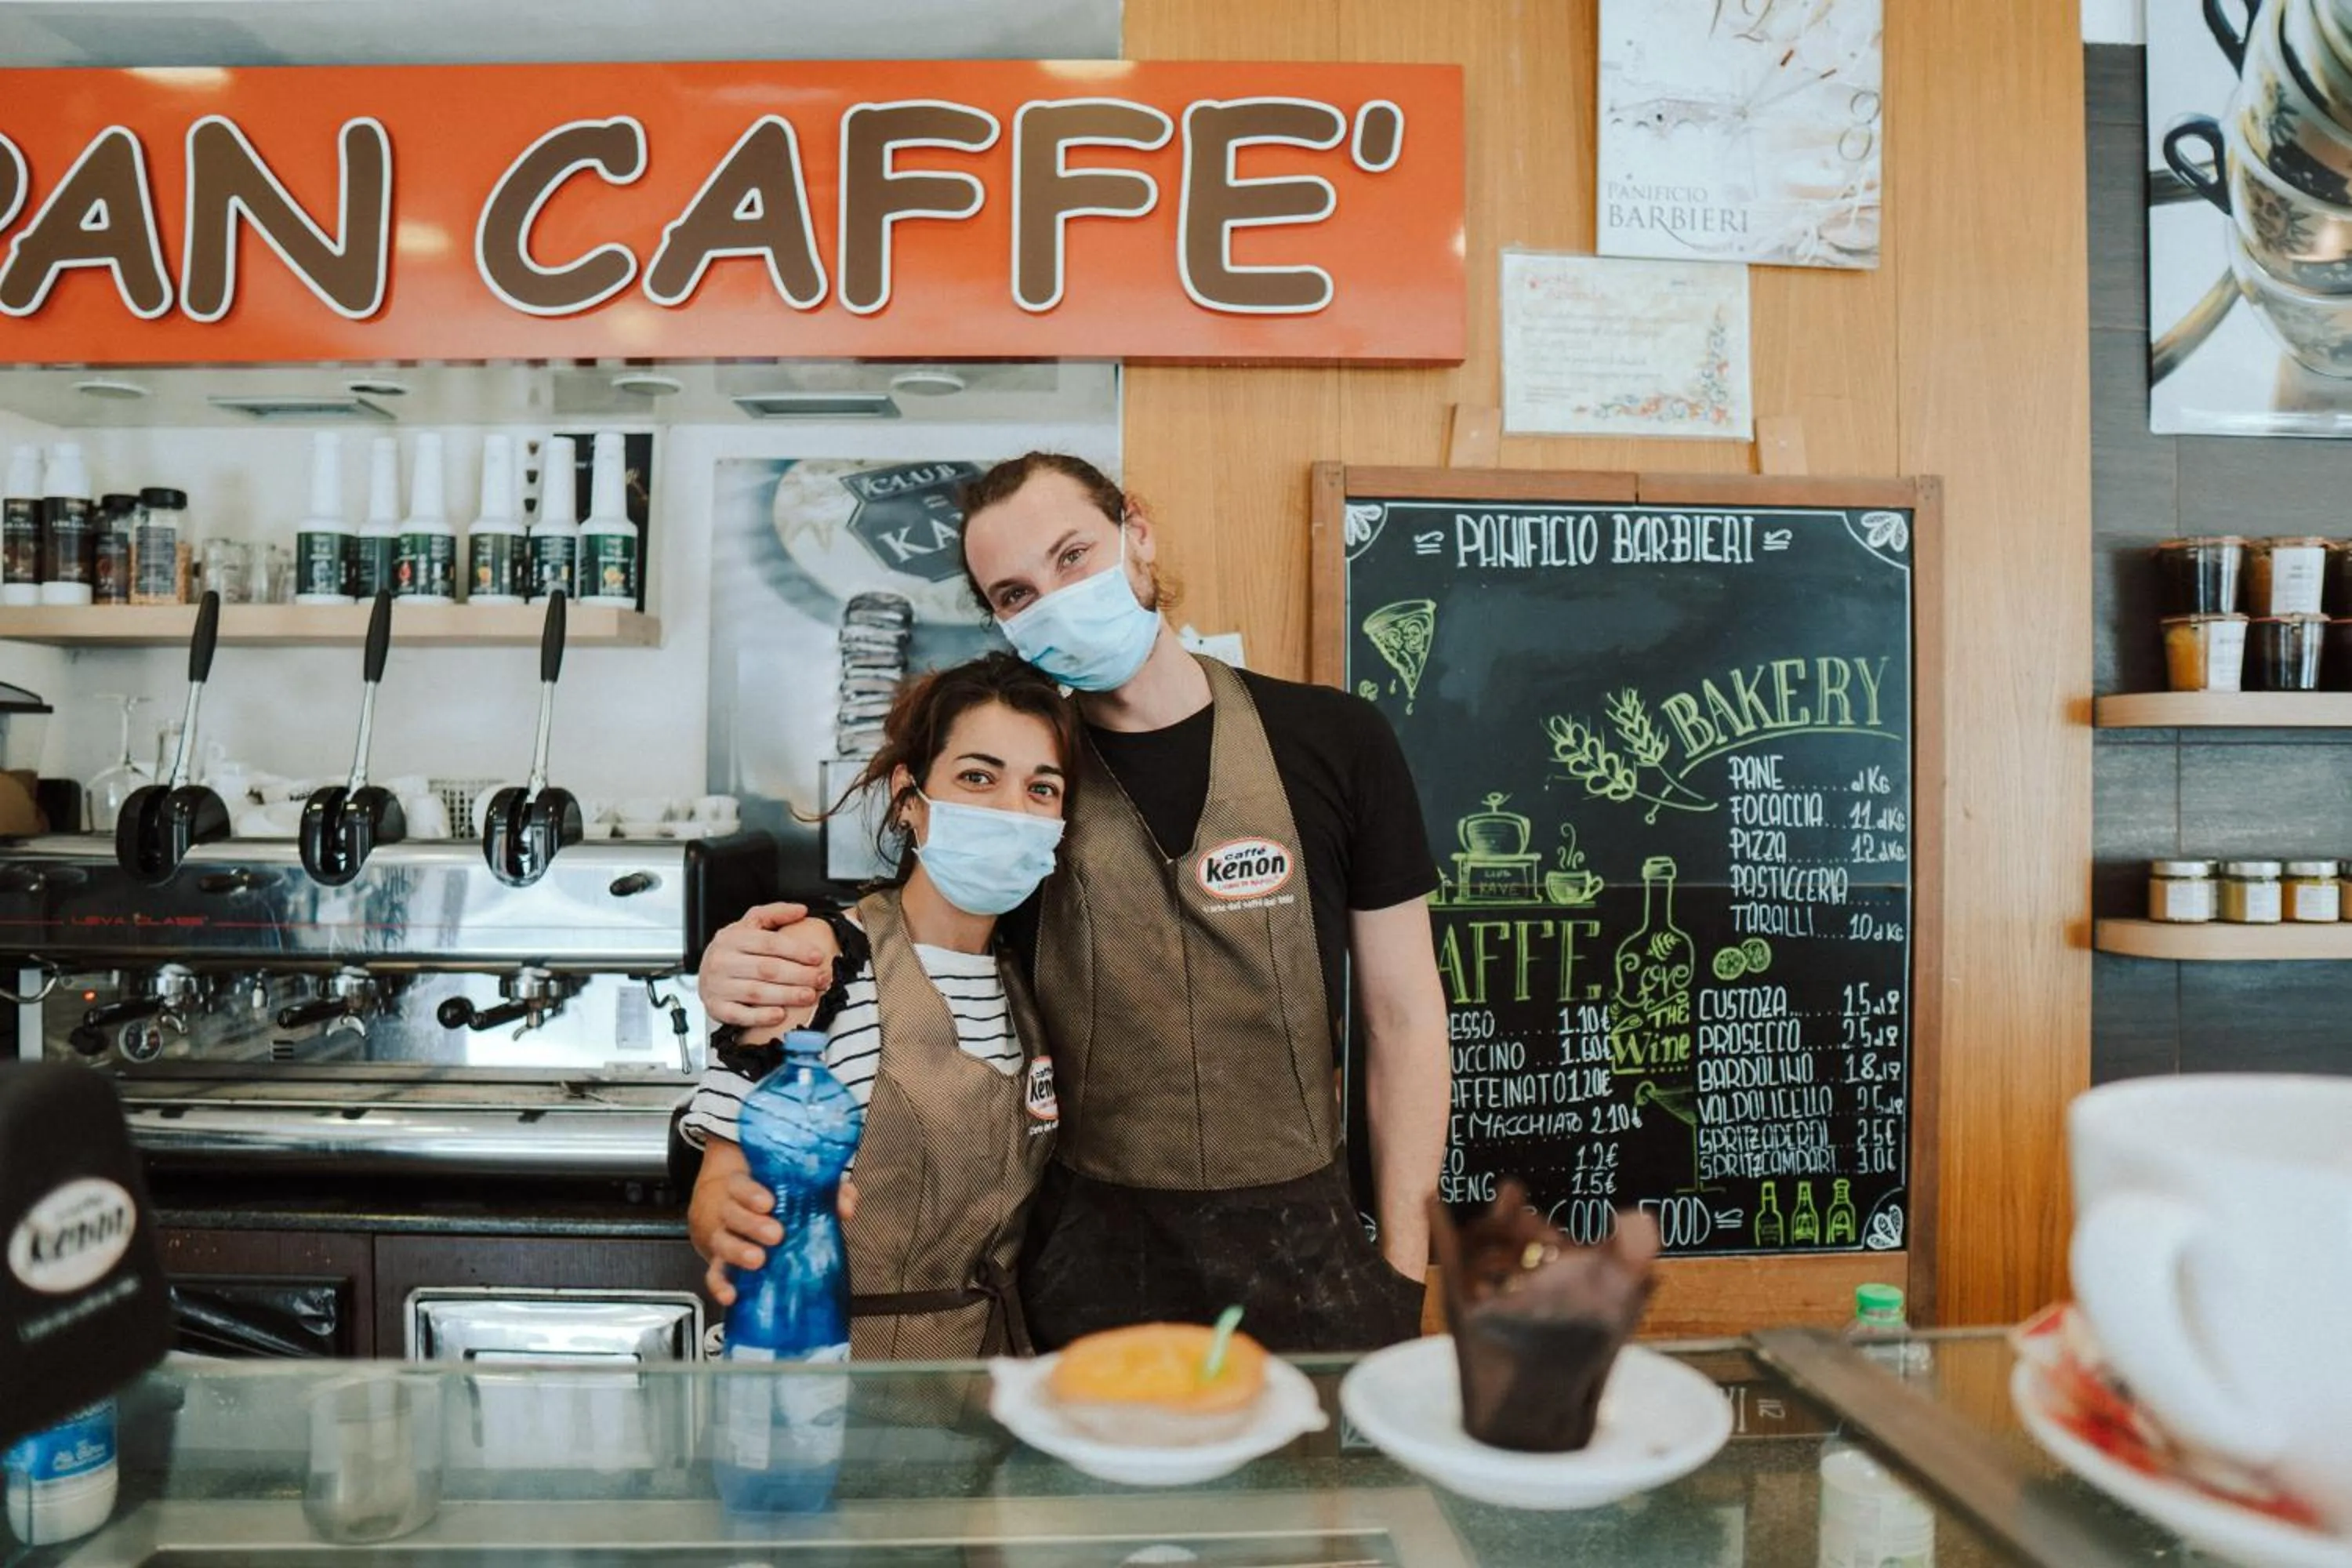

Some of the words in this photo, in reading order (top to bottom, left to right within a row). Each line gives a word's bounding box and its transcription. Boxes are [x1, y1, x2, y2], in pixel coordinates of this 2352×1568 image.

[1607, 180, 1709, 203] PANIFICIO
[0, 114, 392, 322] AN
[1608, 204, 1748, 234] BARBIERI
[876, 512, 965, 564] KA
[1456, 513, 1599, 568] PANIFICIO
[1612, 514, 1755, 564] BARBIERI
[1661, 655, 1890, 759] BAKERY
[1729, 754, 1785, 790] PANE
[1729, 792, 1824, 828] FOCACCIA
[1729, 827, 1788, 863] PIZZA
[1207, 855, 1285, 884] kenon
[1730, 864, 1849, 906] PASTICCERIA
[1730, 901, 1814, 938] TARALLI
[1438, 919, 1602, 1004] AFFE
[1647, 1000, 1690, 1029] THE
[1699, 985, 1788, 1022] CUSTOZA
[1449, 1009, 1496, 1041] ESSO
[1698, 1018, 1801, 1057] PROSECCO
[1450, 1040, 1526, 1075] UCCINO
[1611, 1032, 1691, 1065] Wine
[1029, 1075, 1054, 1102] ken
[1450, 1071, 1566, 1109] AFFEINATO
[1697, 1052, 1815, 1093] BARDOLINO
[1468, 1111, 1583, 1141] MACCHIATO
[1440, 1172, 1497, 1203] SENG
